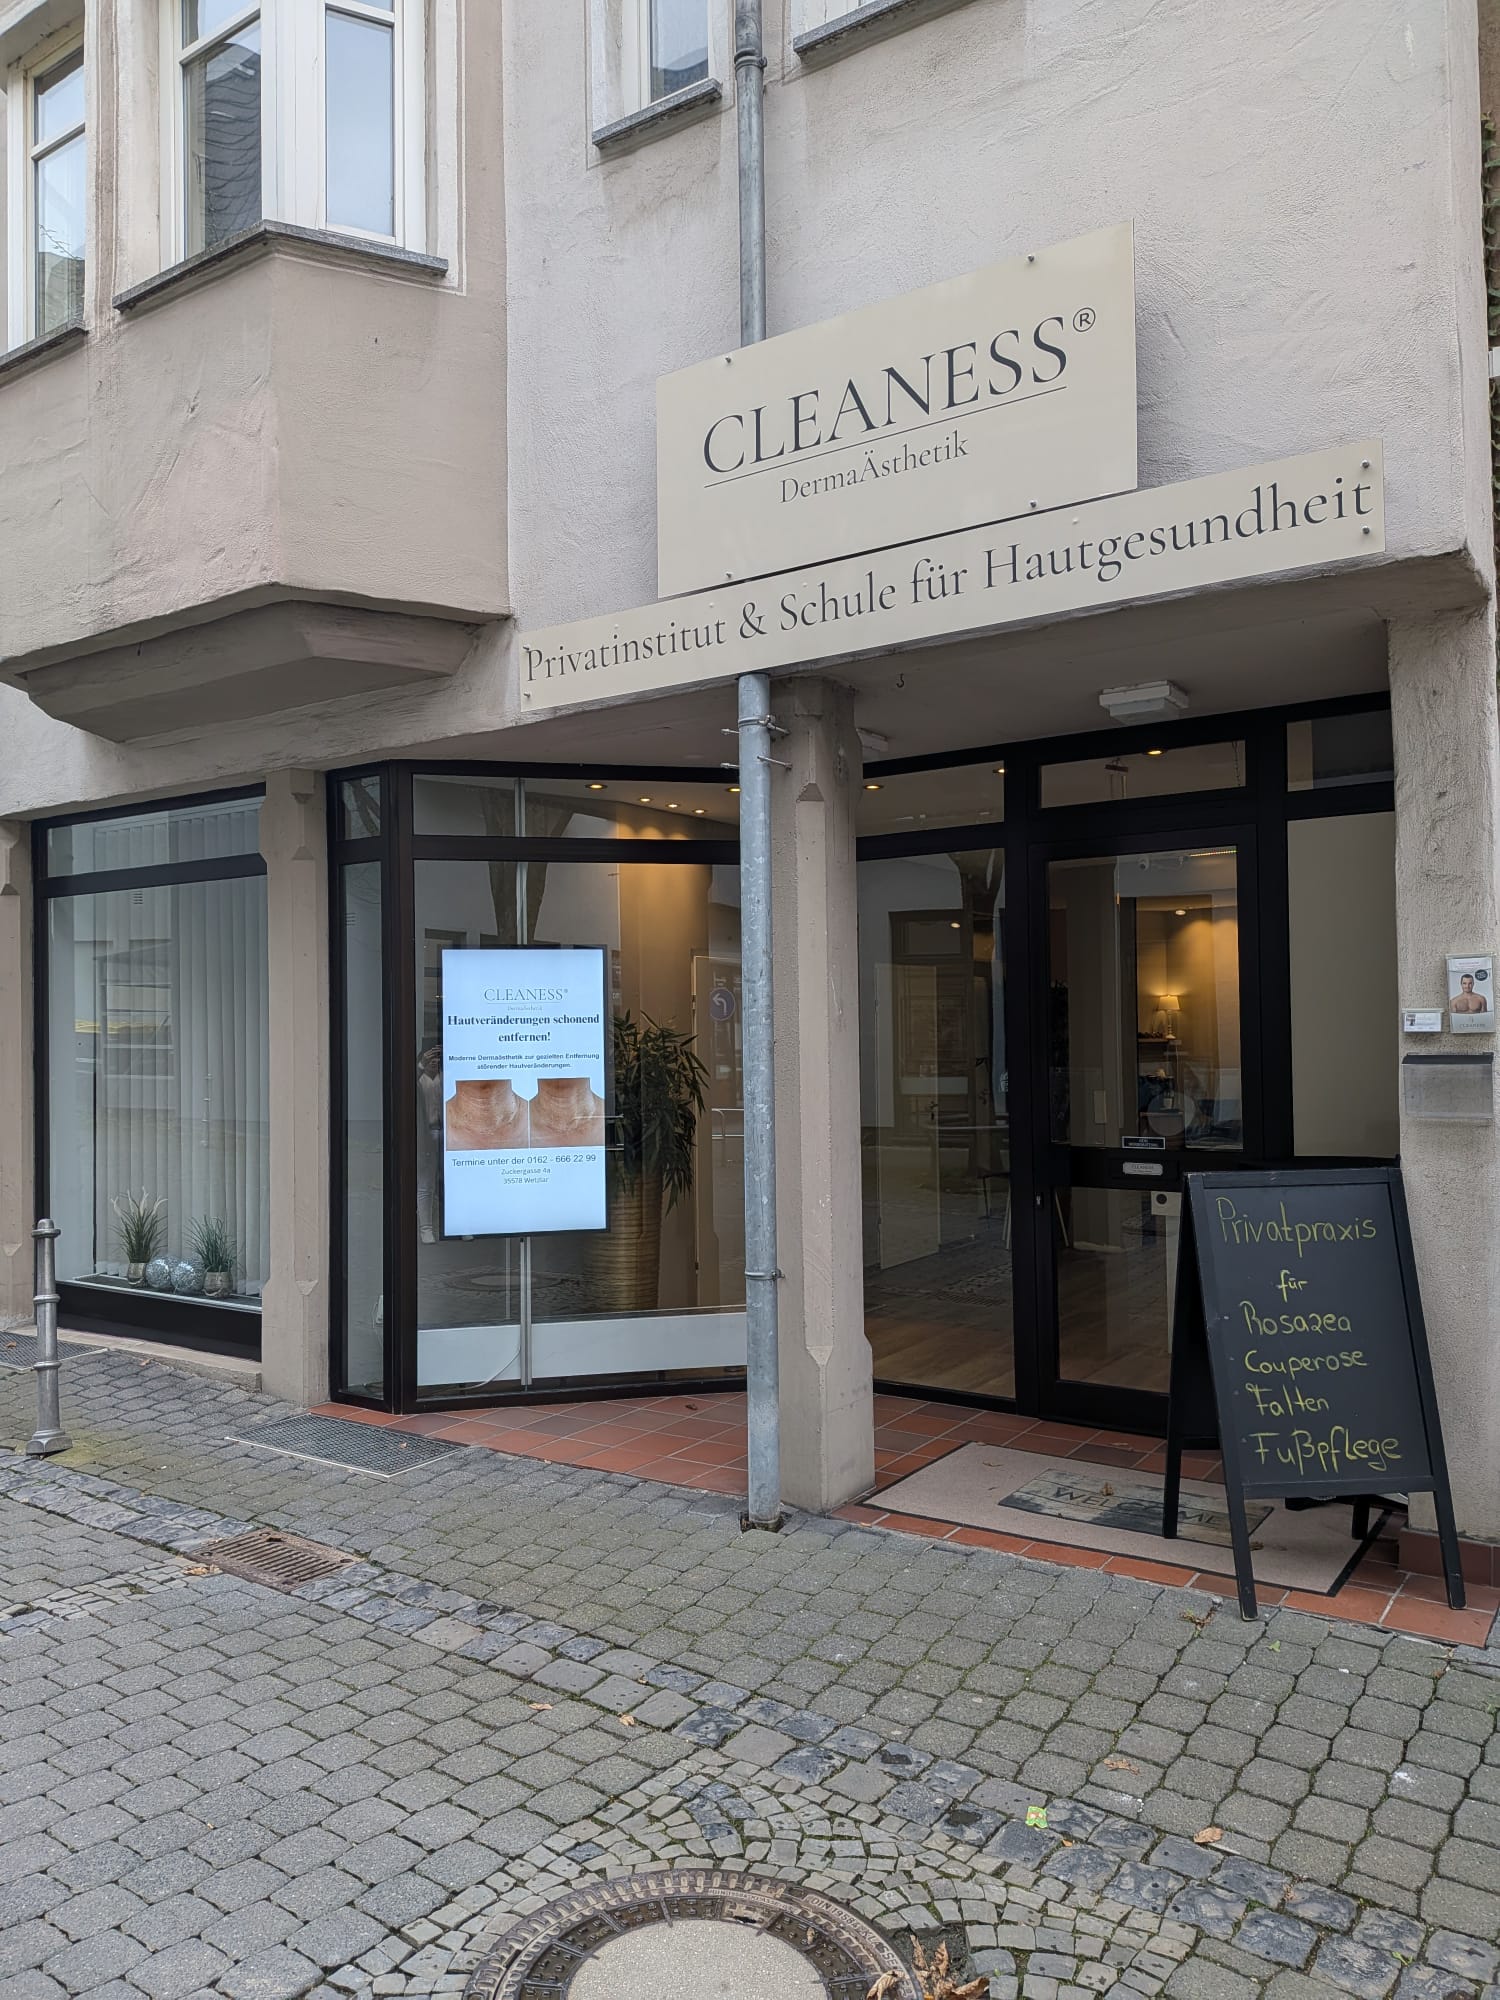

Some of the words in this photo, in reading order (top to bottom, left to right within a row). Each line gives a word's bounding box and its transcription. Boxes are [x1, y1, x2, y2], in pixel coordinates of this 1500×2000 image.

[704, 307, 1096, 474] CLEANESS®
[779, 430, 969, 503] DermaÄsthetik
[525, 614, 727, 682] Privatinstitut
[739, 603, 768, 640] &
[779, 581, 897, 630] Schule
[910, 558, 969, 604] für
[984, 477, 1373, 583] Hautgesundheit
[447, 1015, 551, 1026] Hautveränderungen
[552, 1014, 600, 1024] schonend
[498, 1031, 552, 1042] entfernen!
[565, 1053, 600, 1061] Entfernung
[451, 1158, 485, 1167] Termine
[487, 1157, 509, 1166] unter
[511, 1156, 525, 1165] der
[527, 1156, 548, 1164] 0162
[555, 1155, 571, 1163] 666
[573, 1154, 584, 1163] 22
[585, 1154, 597, 1162] 99
[1215, 1197, 1377, 1258] Privatpraxis
[1276, 1269, 1308, 1303] für
[1244, 1350, 1367, 1380] Couperose
[1245, 1383, 1330, 1417] Falten
[1250, 1425, 1403, 1476] Fußpflege
[811, 1898, 832, 1911] DIN
